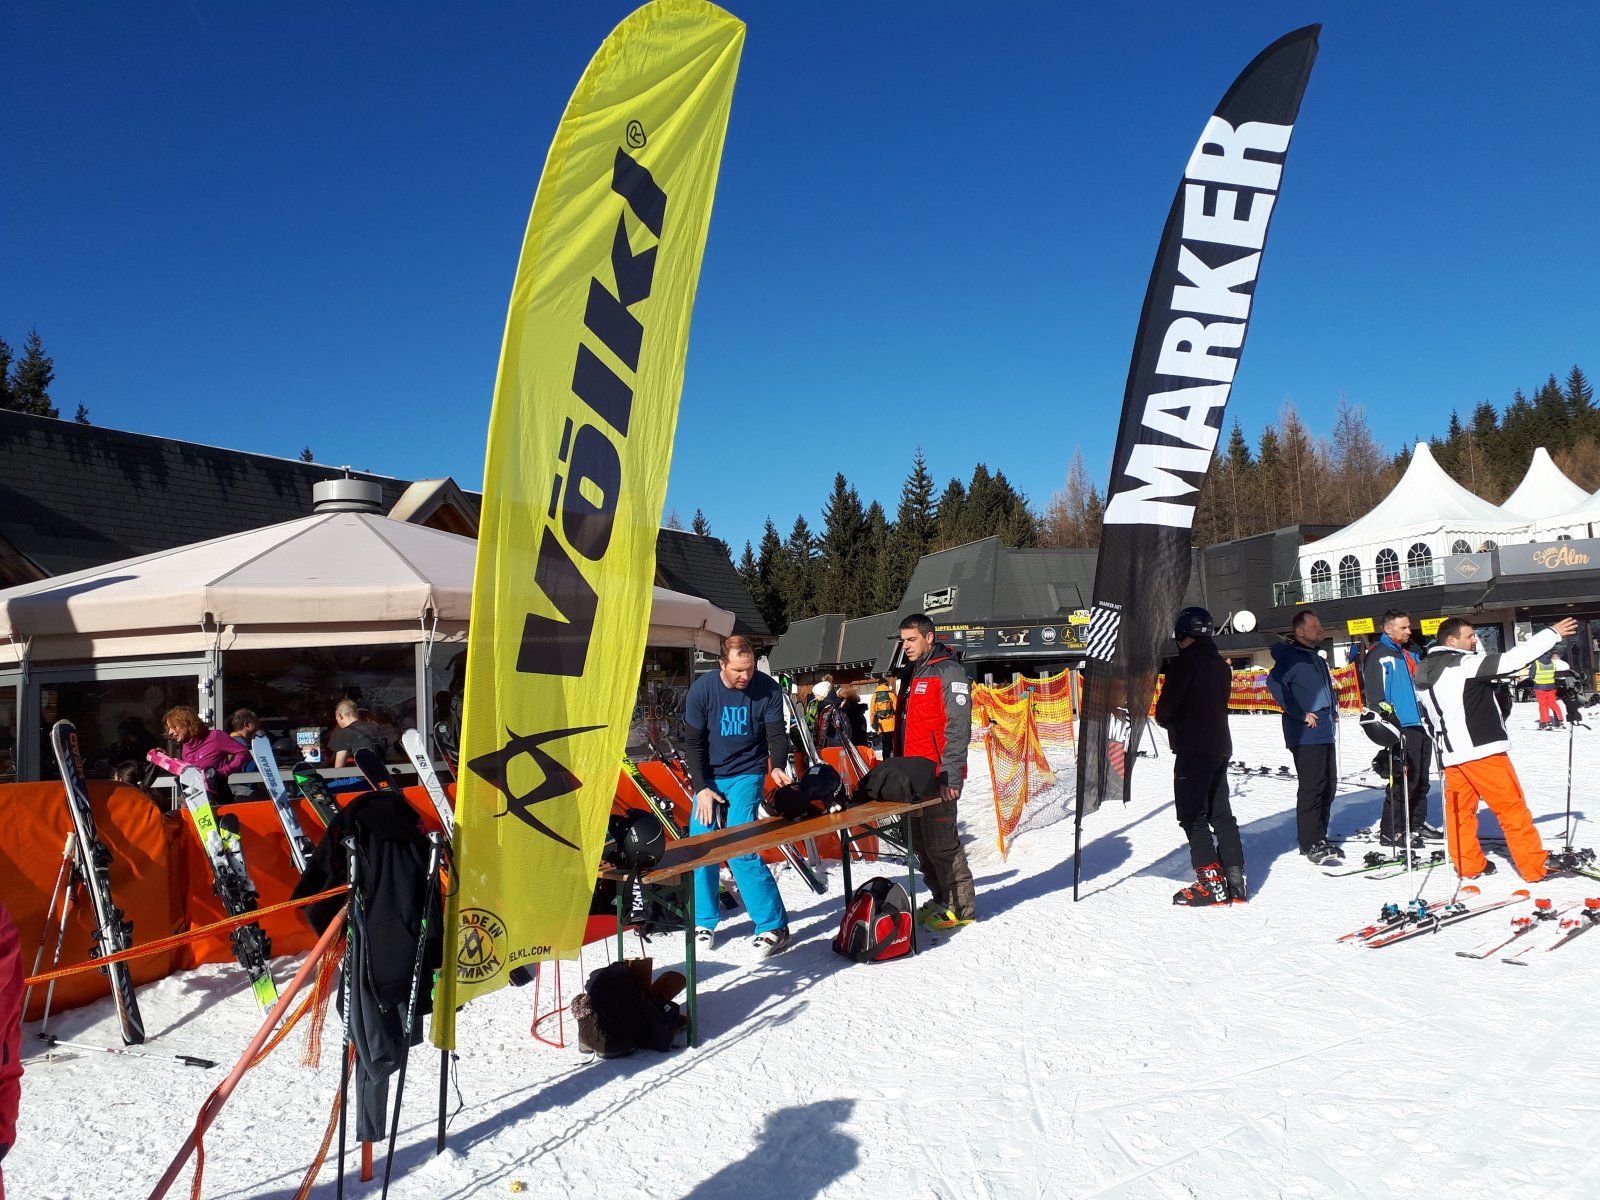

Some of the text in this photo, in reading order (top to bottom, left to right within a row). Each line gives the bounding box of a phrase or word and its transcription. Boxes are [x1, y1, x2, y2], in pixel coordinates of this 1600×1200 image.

[1103, 116, 1294, 528] MARKER
[260, 756, 278, 788] SCREAM
[459, 914, 503, 938] ADE IN
[509, 946, 551, 962] ELKL.COM
